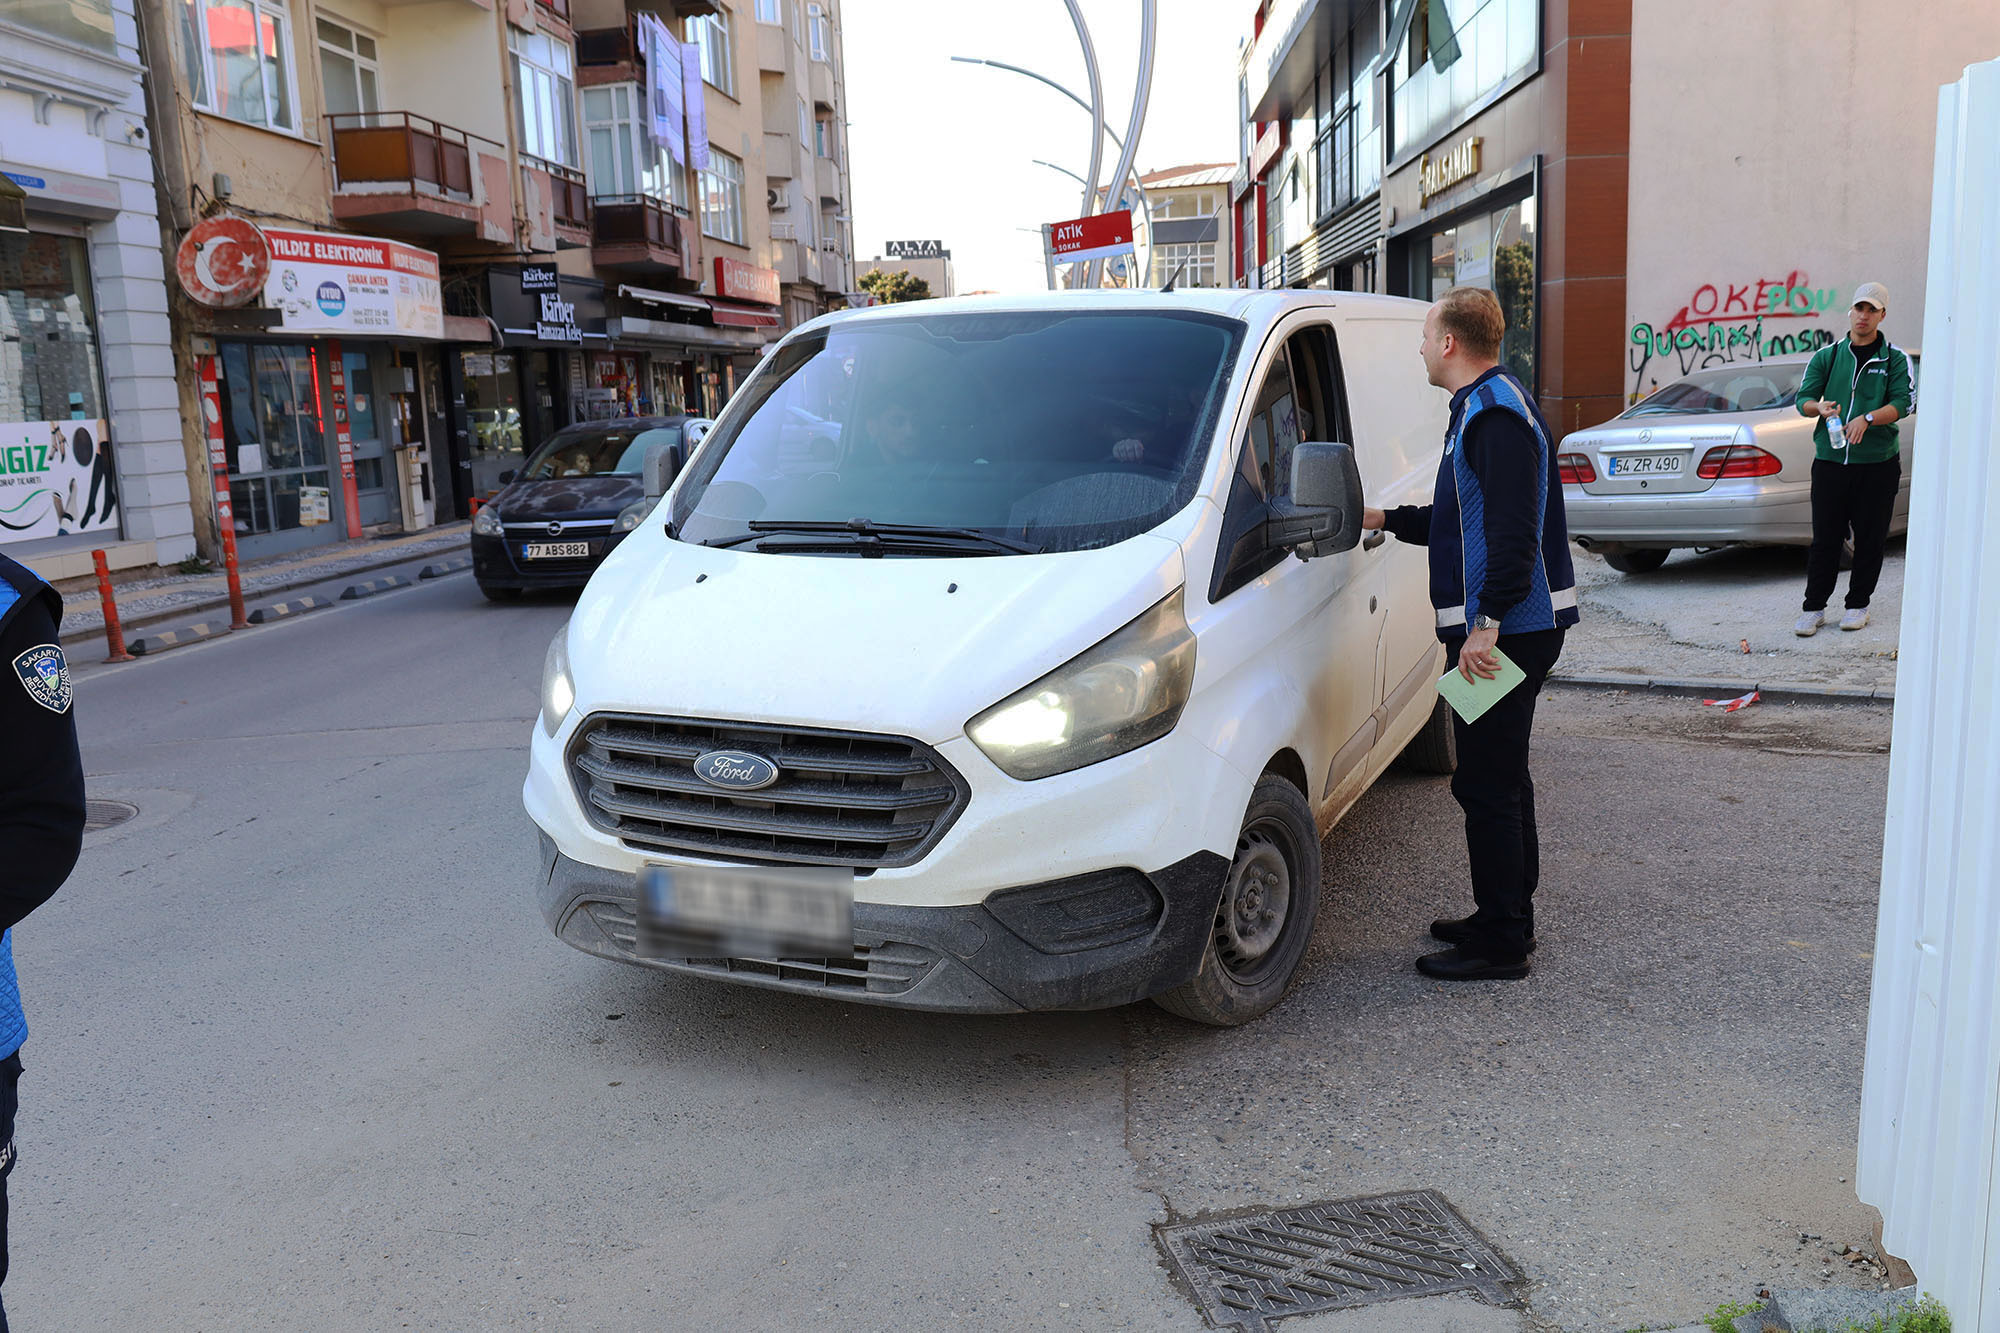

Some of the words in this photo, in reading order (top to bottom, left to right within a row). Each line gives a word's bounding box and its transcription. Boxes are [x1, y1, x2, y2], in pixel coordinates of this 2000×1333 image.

[1057, 223, 1084, 241] ATİK
[271, 238, 312, 258] YILDIZ
[314, 242, 385, 265] ELEKTRONİK
[890, 240, 937, 251] ALYA
[1058, 241, 1081, 252] SOKAK
[522, 268, 555, 281] Barber
[541, 293, 575, 323] Barber
[1616, 458, 1630, 473] 54
[1633, 458, 1652, 472] ZR
[1655, 456, 1680, 471] 490
[528, 545, 541, 556] 77
[22, 649, 61, 668] SAKARYA
[709, 756, 756, 781] Ford
